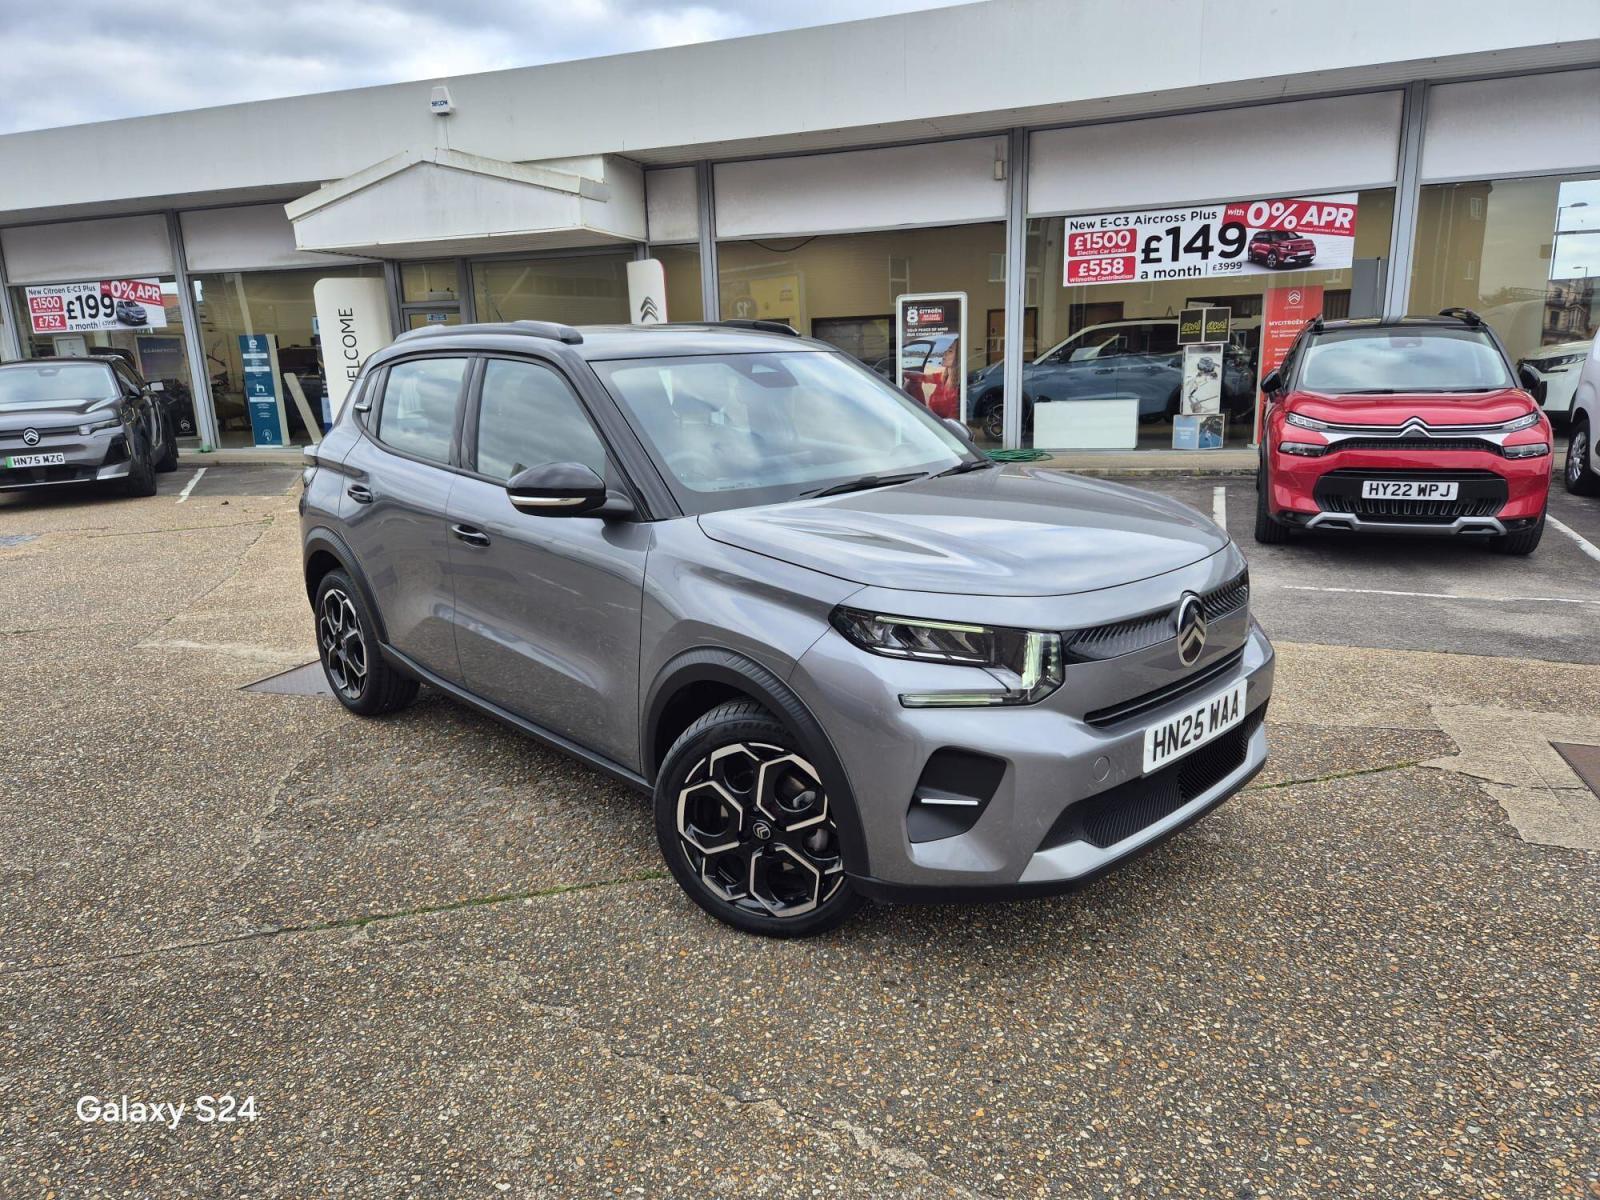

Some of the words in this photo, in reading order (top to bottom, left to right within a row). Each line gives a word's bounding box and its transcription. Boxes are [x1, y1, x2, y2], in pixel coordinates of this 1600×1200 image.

[1070, 221, 1096, 231] New
[1100, 217, 1130, 228] E-C3
[1134, 213, 1186, 226] Aircross
[1190, 210, 1217, 221] Plus
[1227, 208, 1245, 216] with
[1246, 201, 1298, 230] 0%
[1300, 205, 1354, 229] APR
[1074, 230, 1131, 250] £1500
[1140, 222, 1247, 264] £149
[1078, 258, 1124, 276] £558
[1140, 271, 1148, 280] a
[1153, 265, 1201, 279] month
[1212, 262, 1242, 271] £3999
[110, 280, 135, 300] 0%
[136, 284, 160, 300] APR
[32, 296, 60, 309] £1500
[66, 293, 115, 319] £199
[38, 315, 61, 327] £752
[907, 309, 919, 323] 8
[75, 321, 99, 330] month
[338, 307, 361, 383] ELCOME
[13, 456, 40, 465] HN75
[42, 454, 63, 463] MZG
[1369, 482, 1413, 496] HY22
[1417, 484, 1451, 497] WPJ
[1153, 708, 1205, 762] HN25
[1209, 689, 1239, 733] WAA
